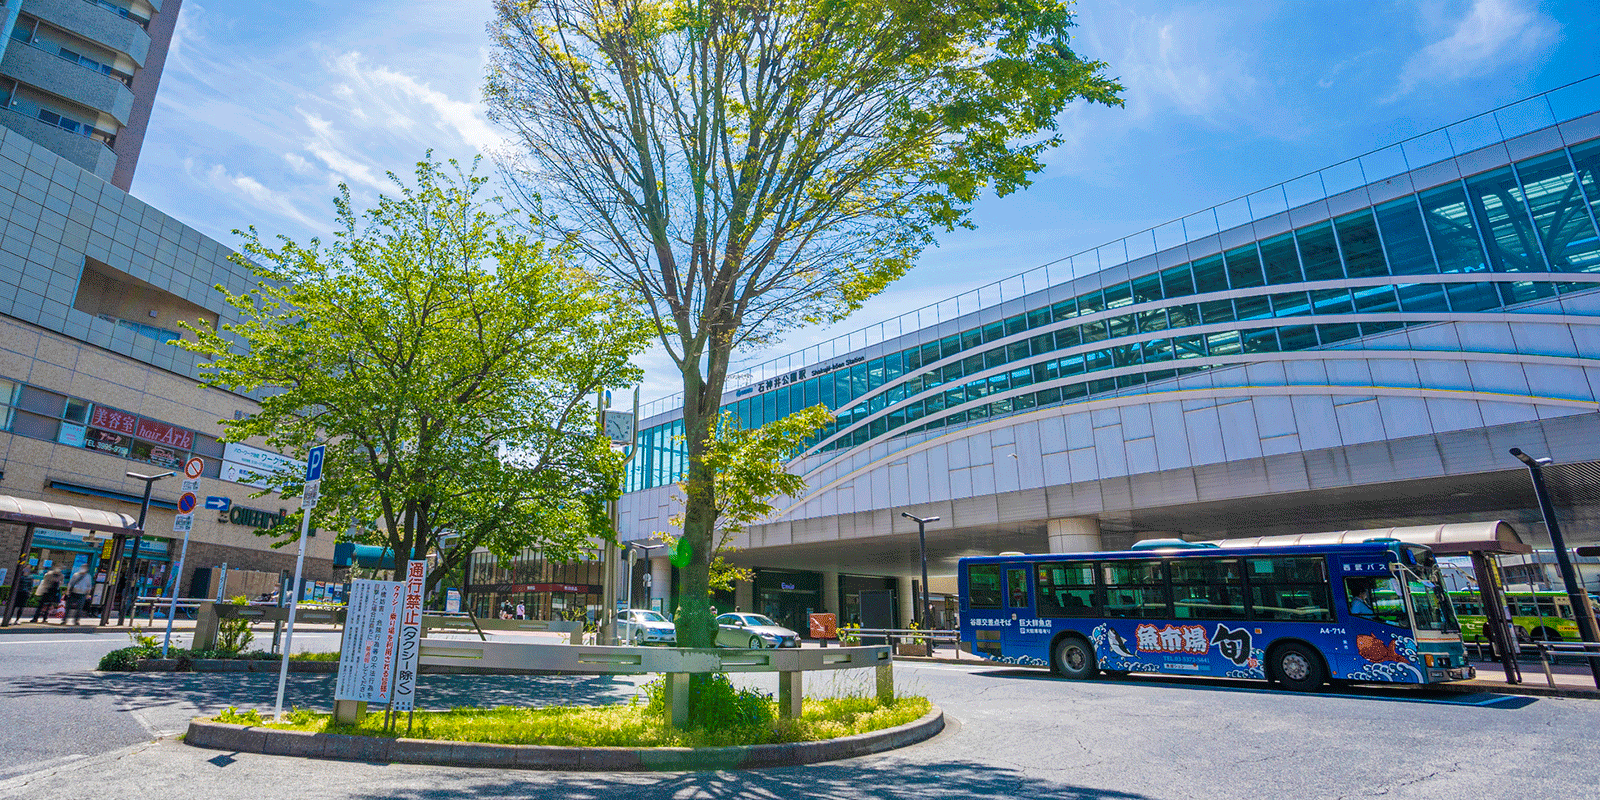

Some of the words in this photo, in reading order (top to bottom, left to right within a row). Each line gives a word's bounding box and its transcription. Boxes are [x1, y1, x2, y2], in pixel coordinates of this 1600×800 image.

[845, 356, 865, 366] Station
[757, 369, 807, 393] 石神井公園駅
[94, 407, 135, 433] 美容室
[138, 425, 161, 440] hair
[161, 427, 191, 448] Ark
[309, 449, 321, 478] P
[1319, 627, 1346, 635] A4-714
[1137, 624, 1208, 654] 魚市場
[1209, 622, 1254, 667] 旬
